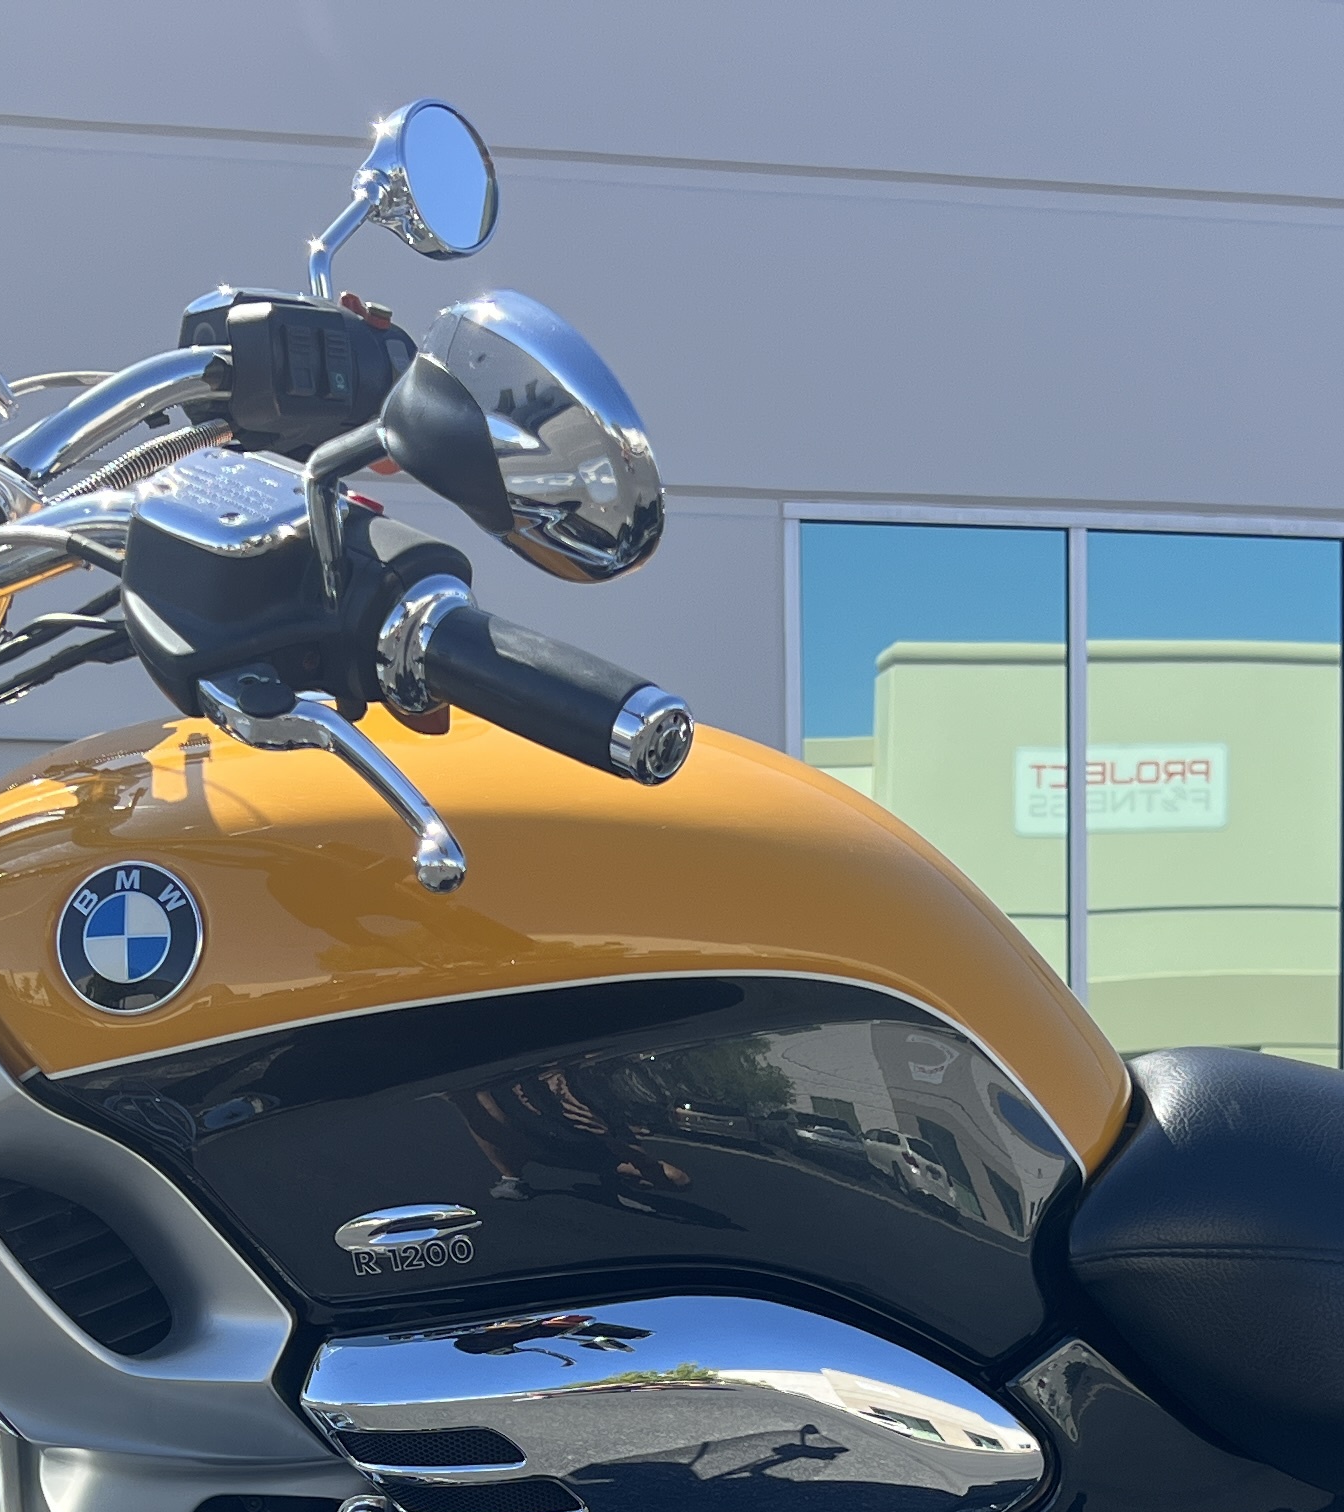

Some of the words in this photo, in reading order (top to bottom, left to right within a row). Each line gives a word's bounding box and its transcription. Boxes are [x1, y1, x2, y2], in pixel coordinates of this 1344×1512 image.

[72, 868, 187, 917] BMW
[351, 1249, 382, 1276] R
[387, 1237, 474, 1272] 1200
